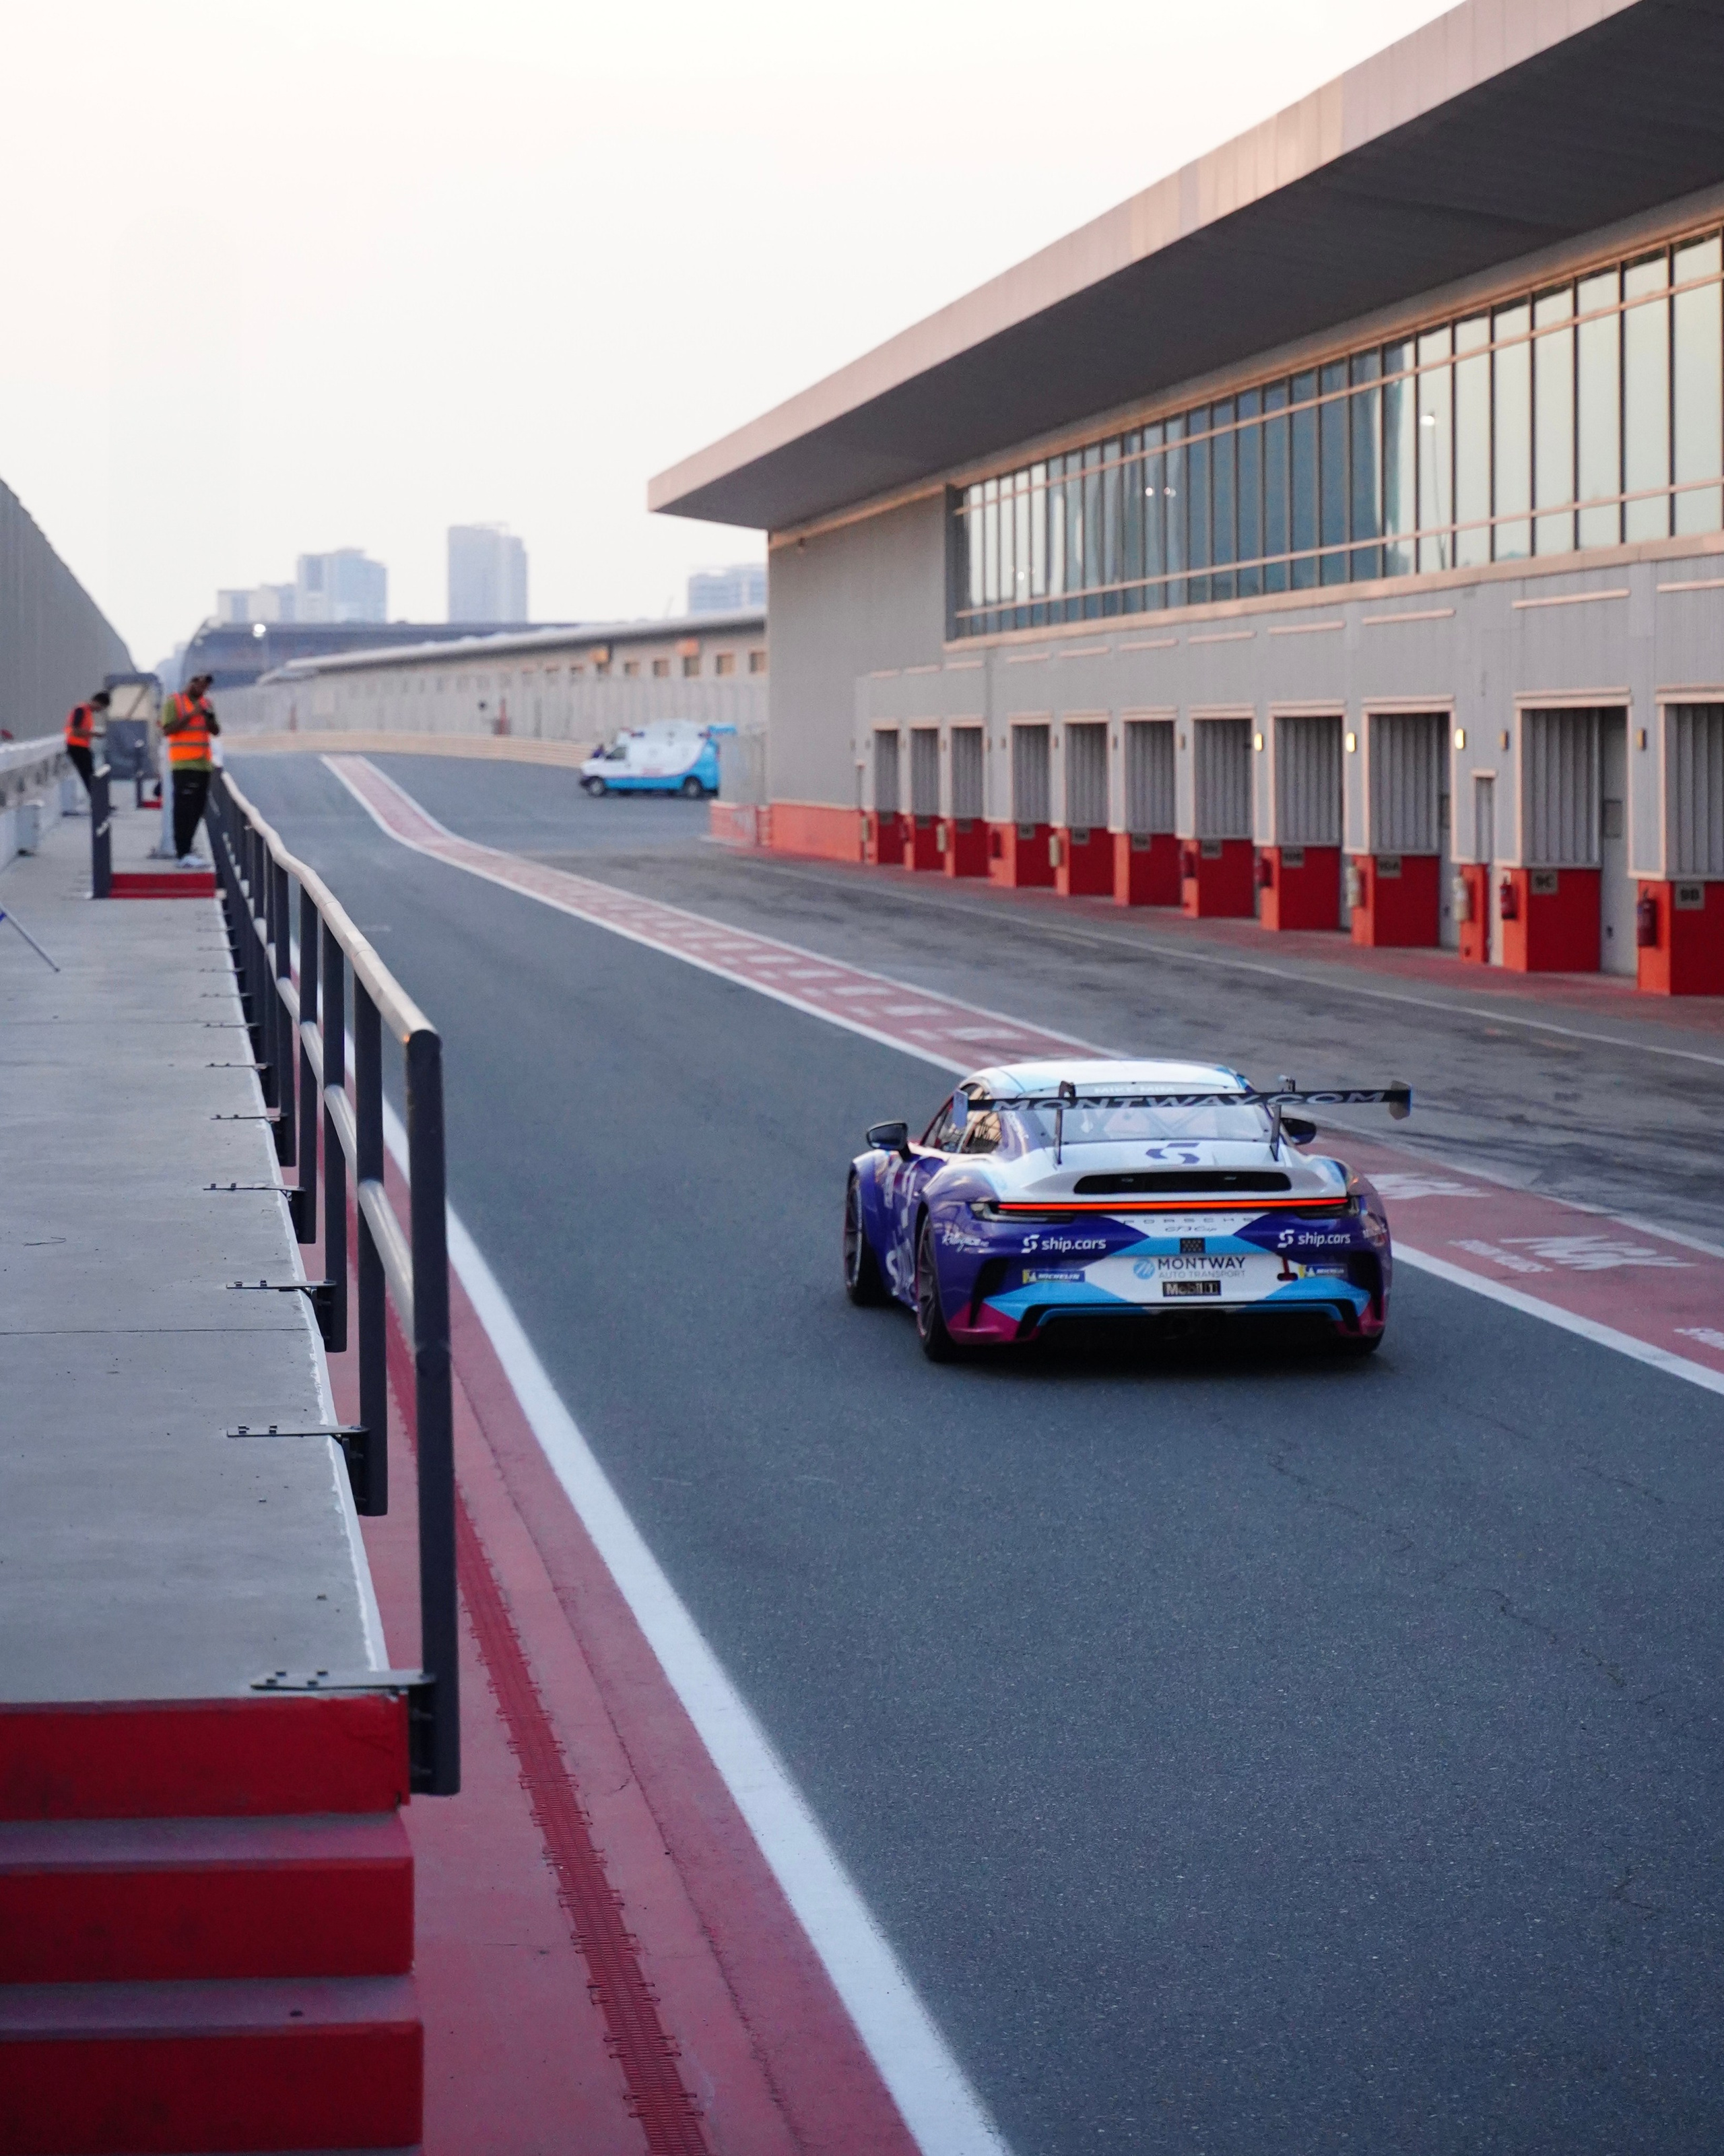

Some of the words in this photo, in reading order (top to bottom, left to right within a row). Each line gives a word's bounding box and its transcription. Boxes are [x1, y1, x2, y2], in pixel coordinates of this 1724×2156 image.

[1041, 1237, 1106, 1253] ship.cars
[1298, 1231, 1351, 1247] ship.cars
[1158, 1257, 1246, 1270] MONTWAY
[1158, 1270, 1186, 1278] AUTO
[1189, 1270, 1246, 1278] TRANSPORT
[1166, 1282, 1203, 1295] Mobil
